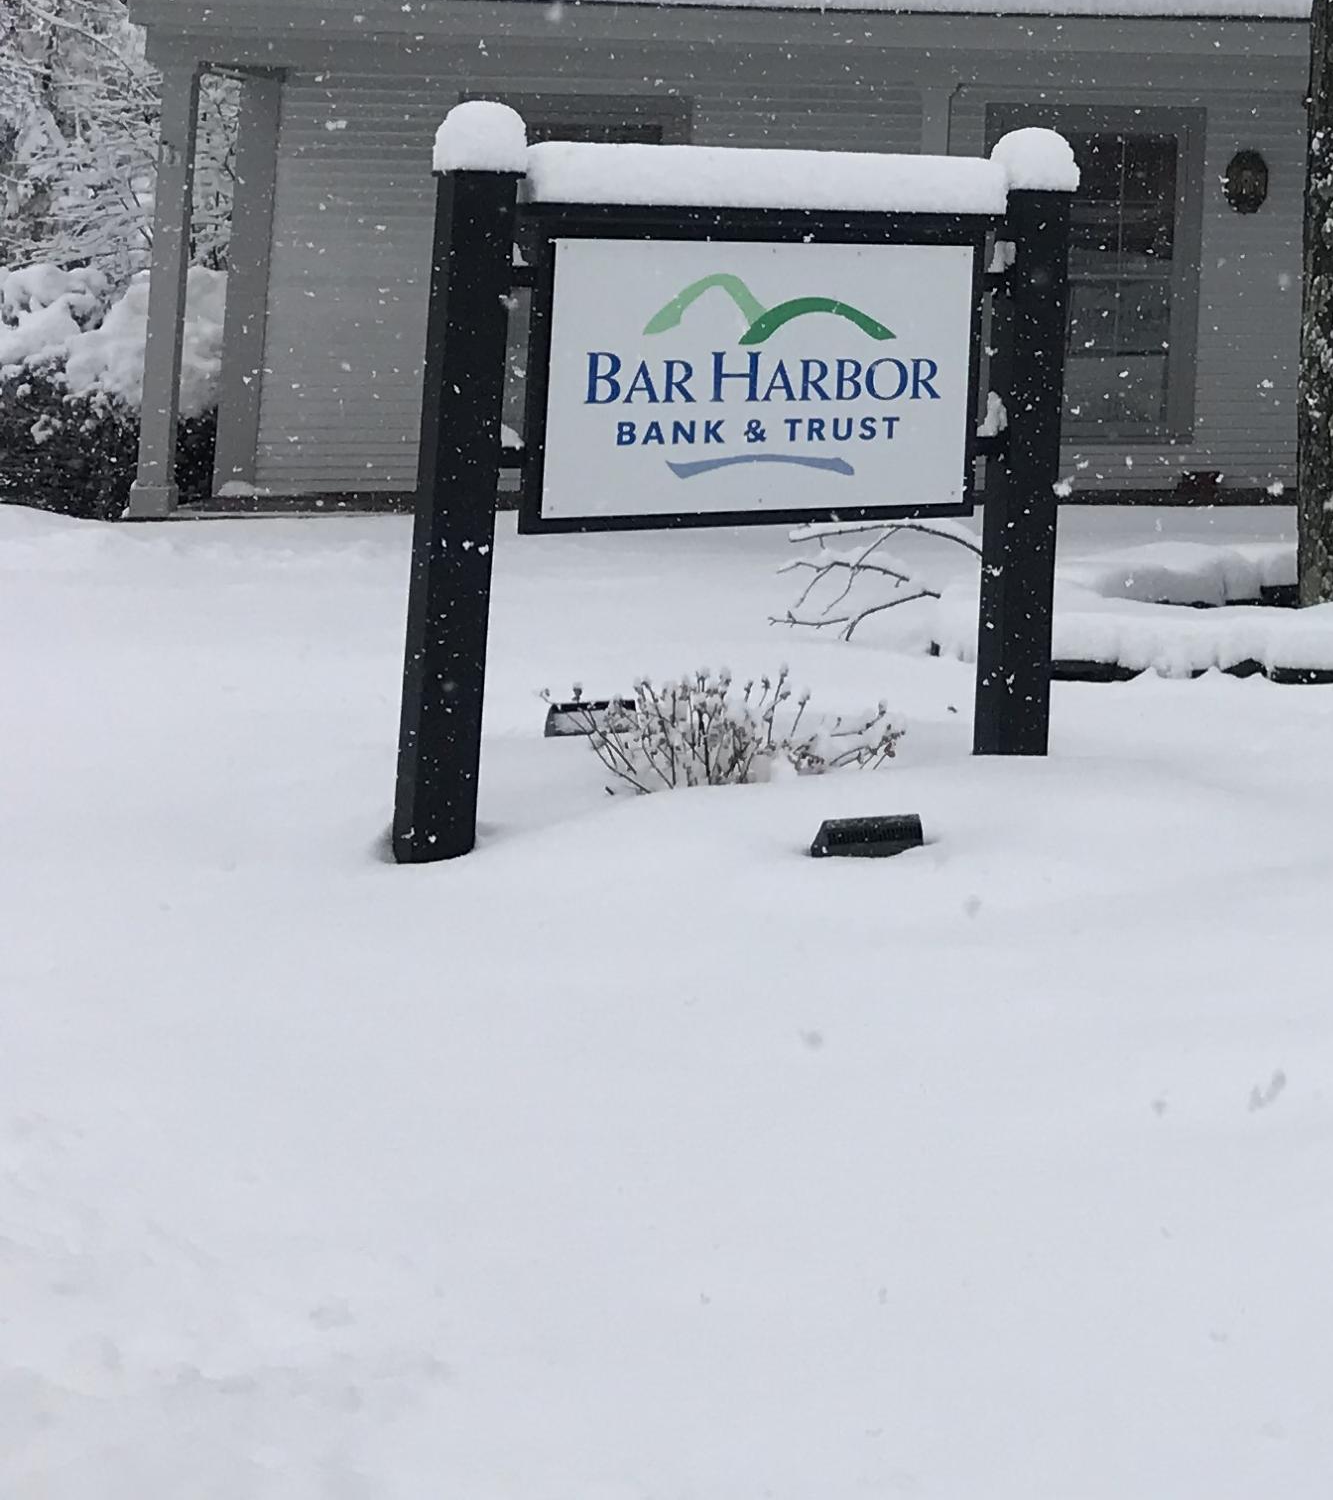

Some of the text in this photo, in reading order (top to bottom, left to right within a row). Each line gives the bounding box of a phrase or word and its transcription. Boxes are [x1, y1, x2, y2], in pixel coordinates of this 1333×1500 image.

[583, 351, 941, 404] BAR HARBOR
[616, 416, 901, 446] BANK & TRUST
